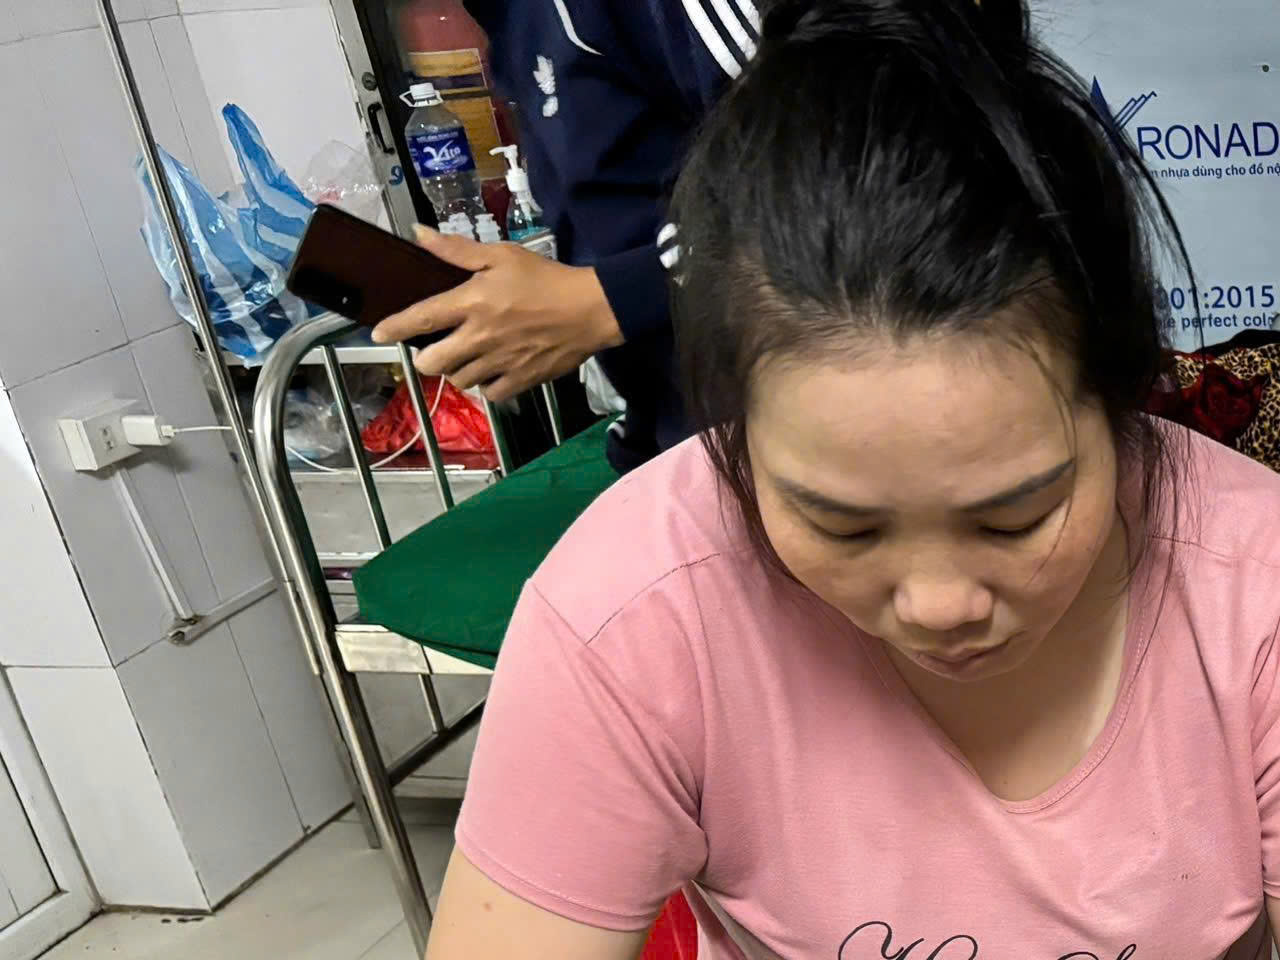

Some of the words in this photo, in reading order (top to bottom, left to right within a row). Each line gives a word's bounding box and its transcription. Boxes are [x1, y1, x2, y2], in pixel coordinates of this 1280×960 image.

[1160, 166, 1190, 180] nhựa
[1193, 165, 1223, 179] dùng
[1225, 163, 1246, 176] cho
[1182, 313, 1238, 331] perfect
